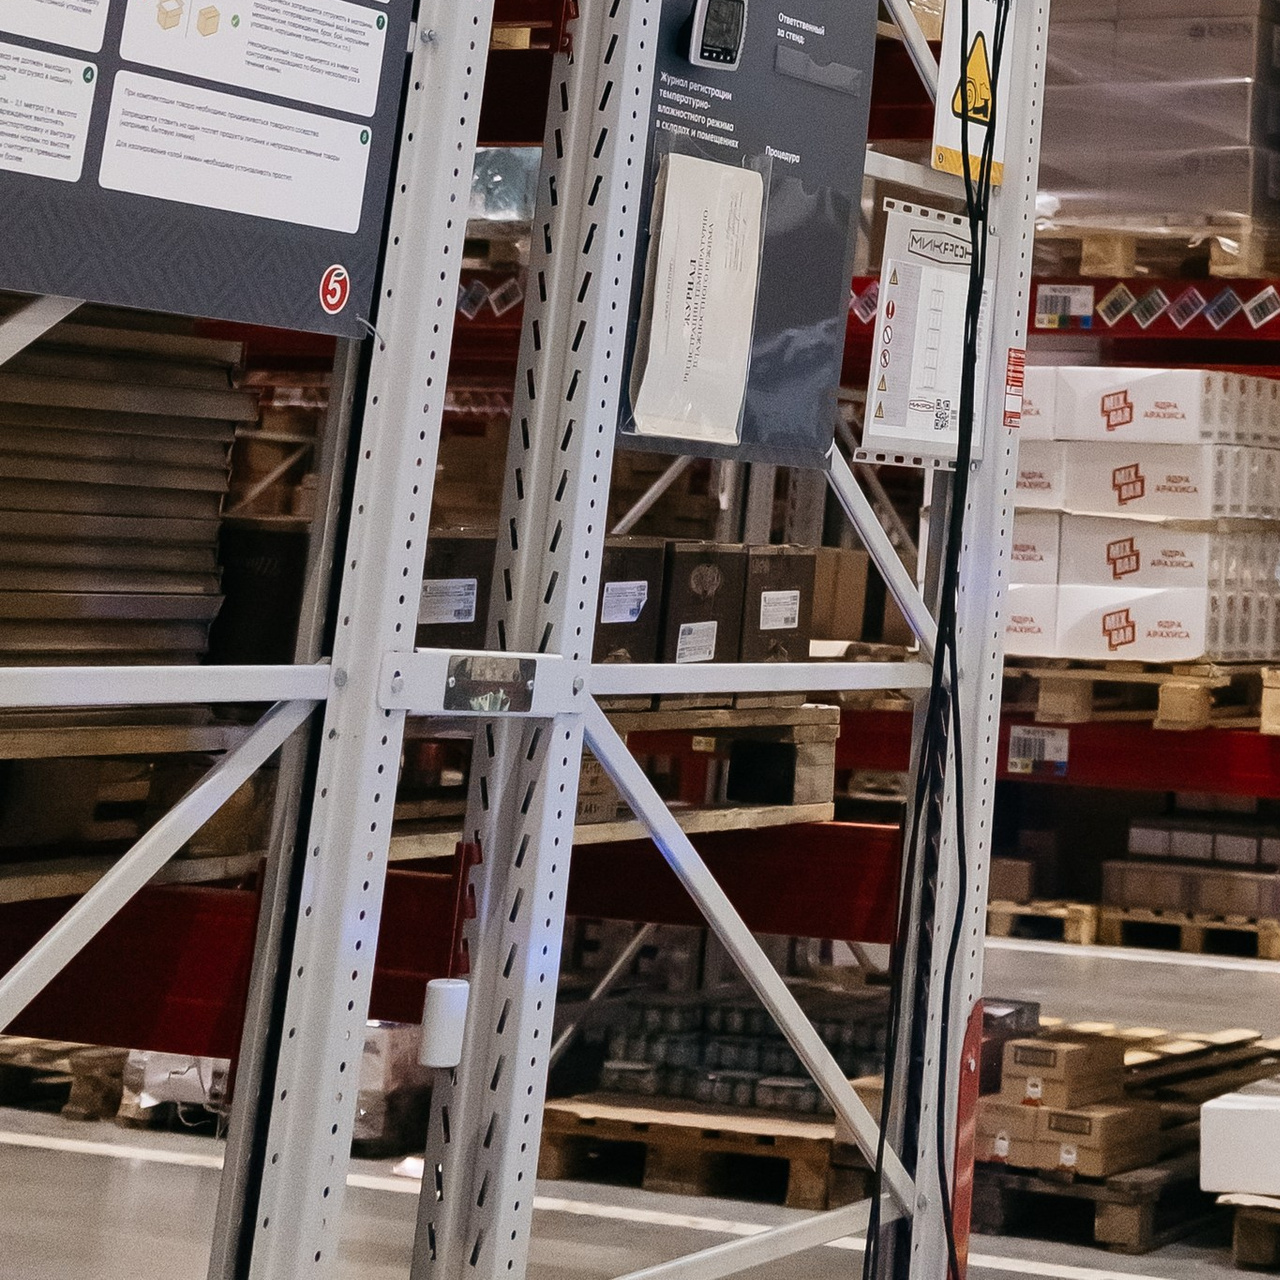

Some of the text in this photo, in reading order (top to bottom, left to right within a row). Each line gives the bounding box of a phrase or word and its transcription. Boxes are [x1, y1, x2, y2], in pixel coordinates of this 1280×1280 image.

[778, 12, 825, 36] Ответственный
[659, 88, 711, 110] температурно-
[660, 71, 732, 101] Журнал регистрации
[657, 104, 735, 132] влажностного режима
[697, 130, 739, 149] помещениях
[765, 146, 801, 164] Процедура
[703, 222, 714, 272] РЕЖИМА
[683, 258, 697, 327] ЖУРНАЛ
[683, 302, 699, 383] РЕГИСТРАЦИИ
